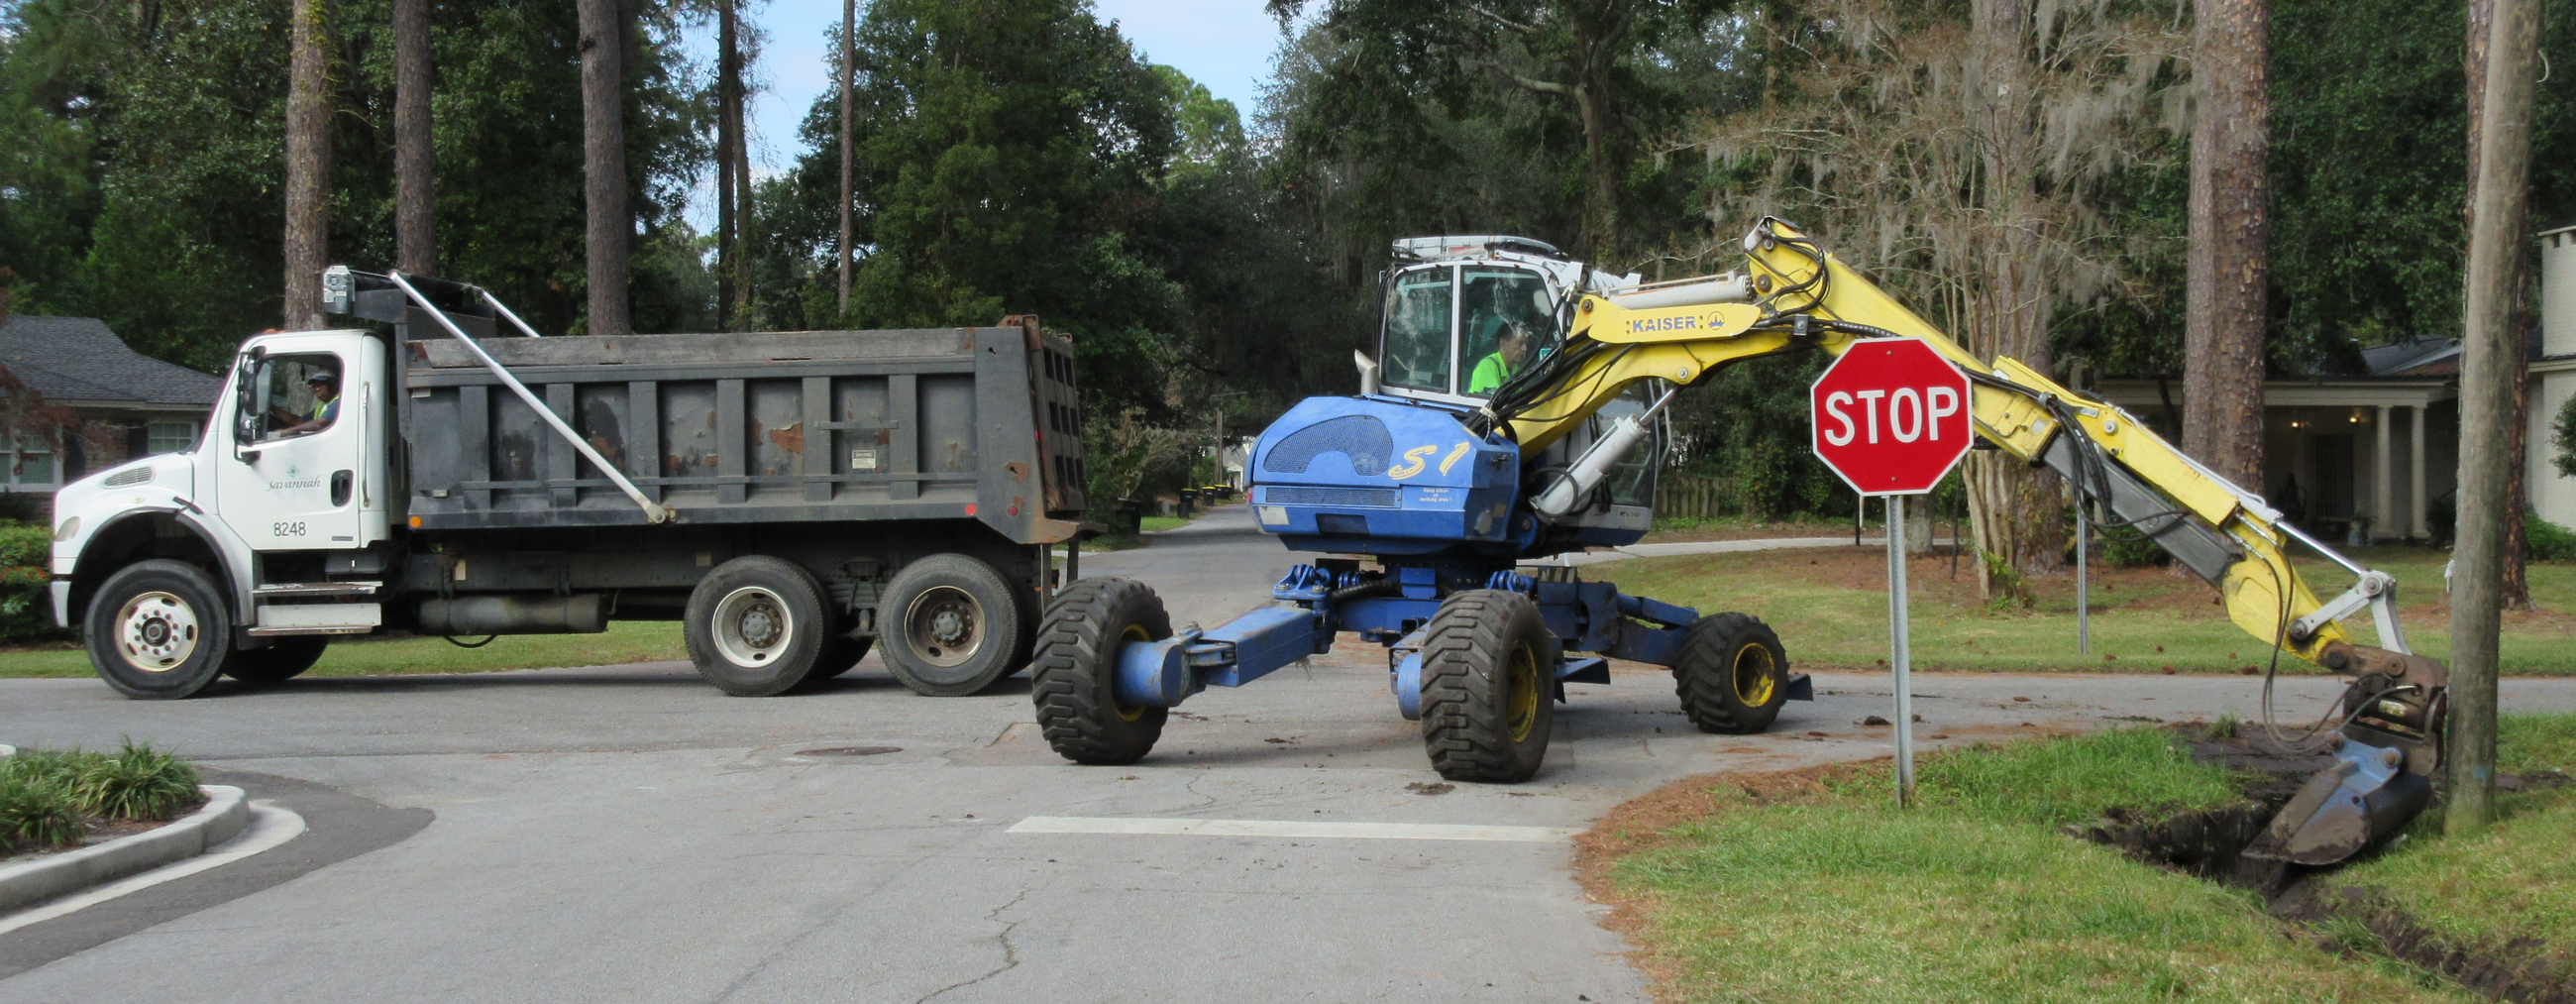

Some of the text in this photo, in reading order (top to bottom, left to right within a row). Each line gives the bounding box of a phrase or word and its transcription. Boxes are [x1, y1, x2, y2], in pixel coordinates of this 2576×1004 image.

[1633, 316, 1696, 333] KAISER
[1824, 386, 1959, 446] STOP
[267, 475, 321, 491] savannah
[273, 521, 306, 536] 8248
